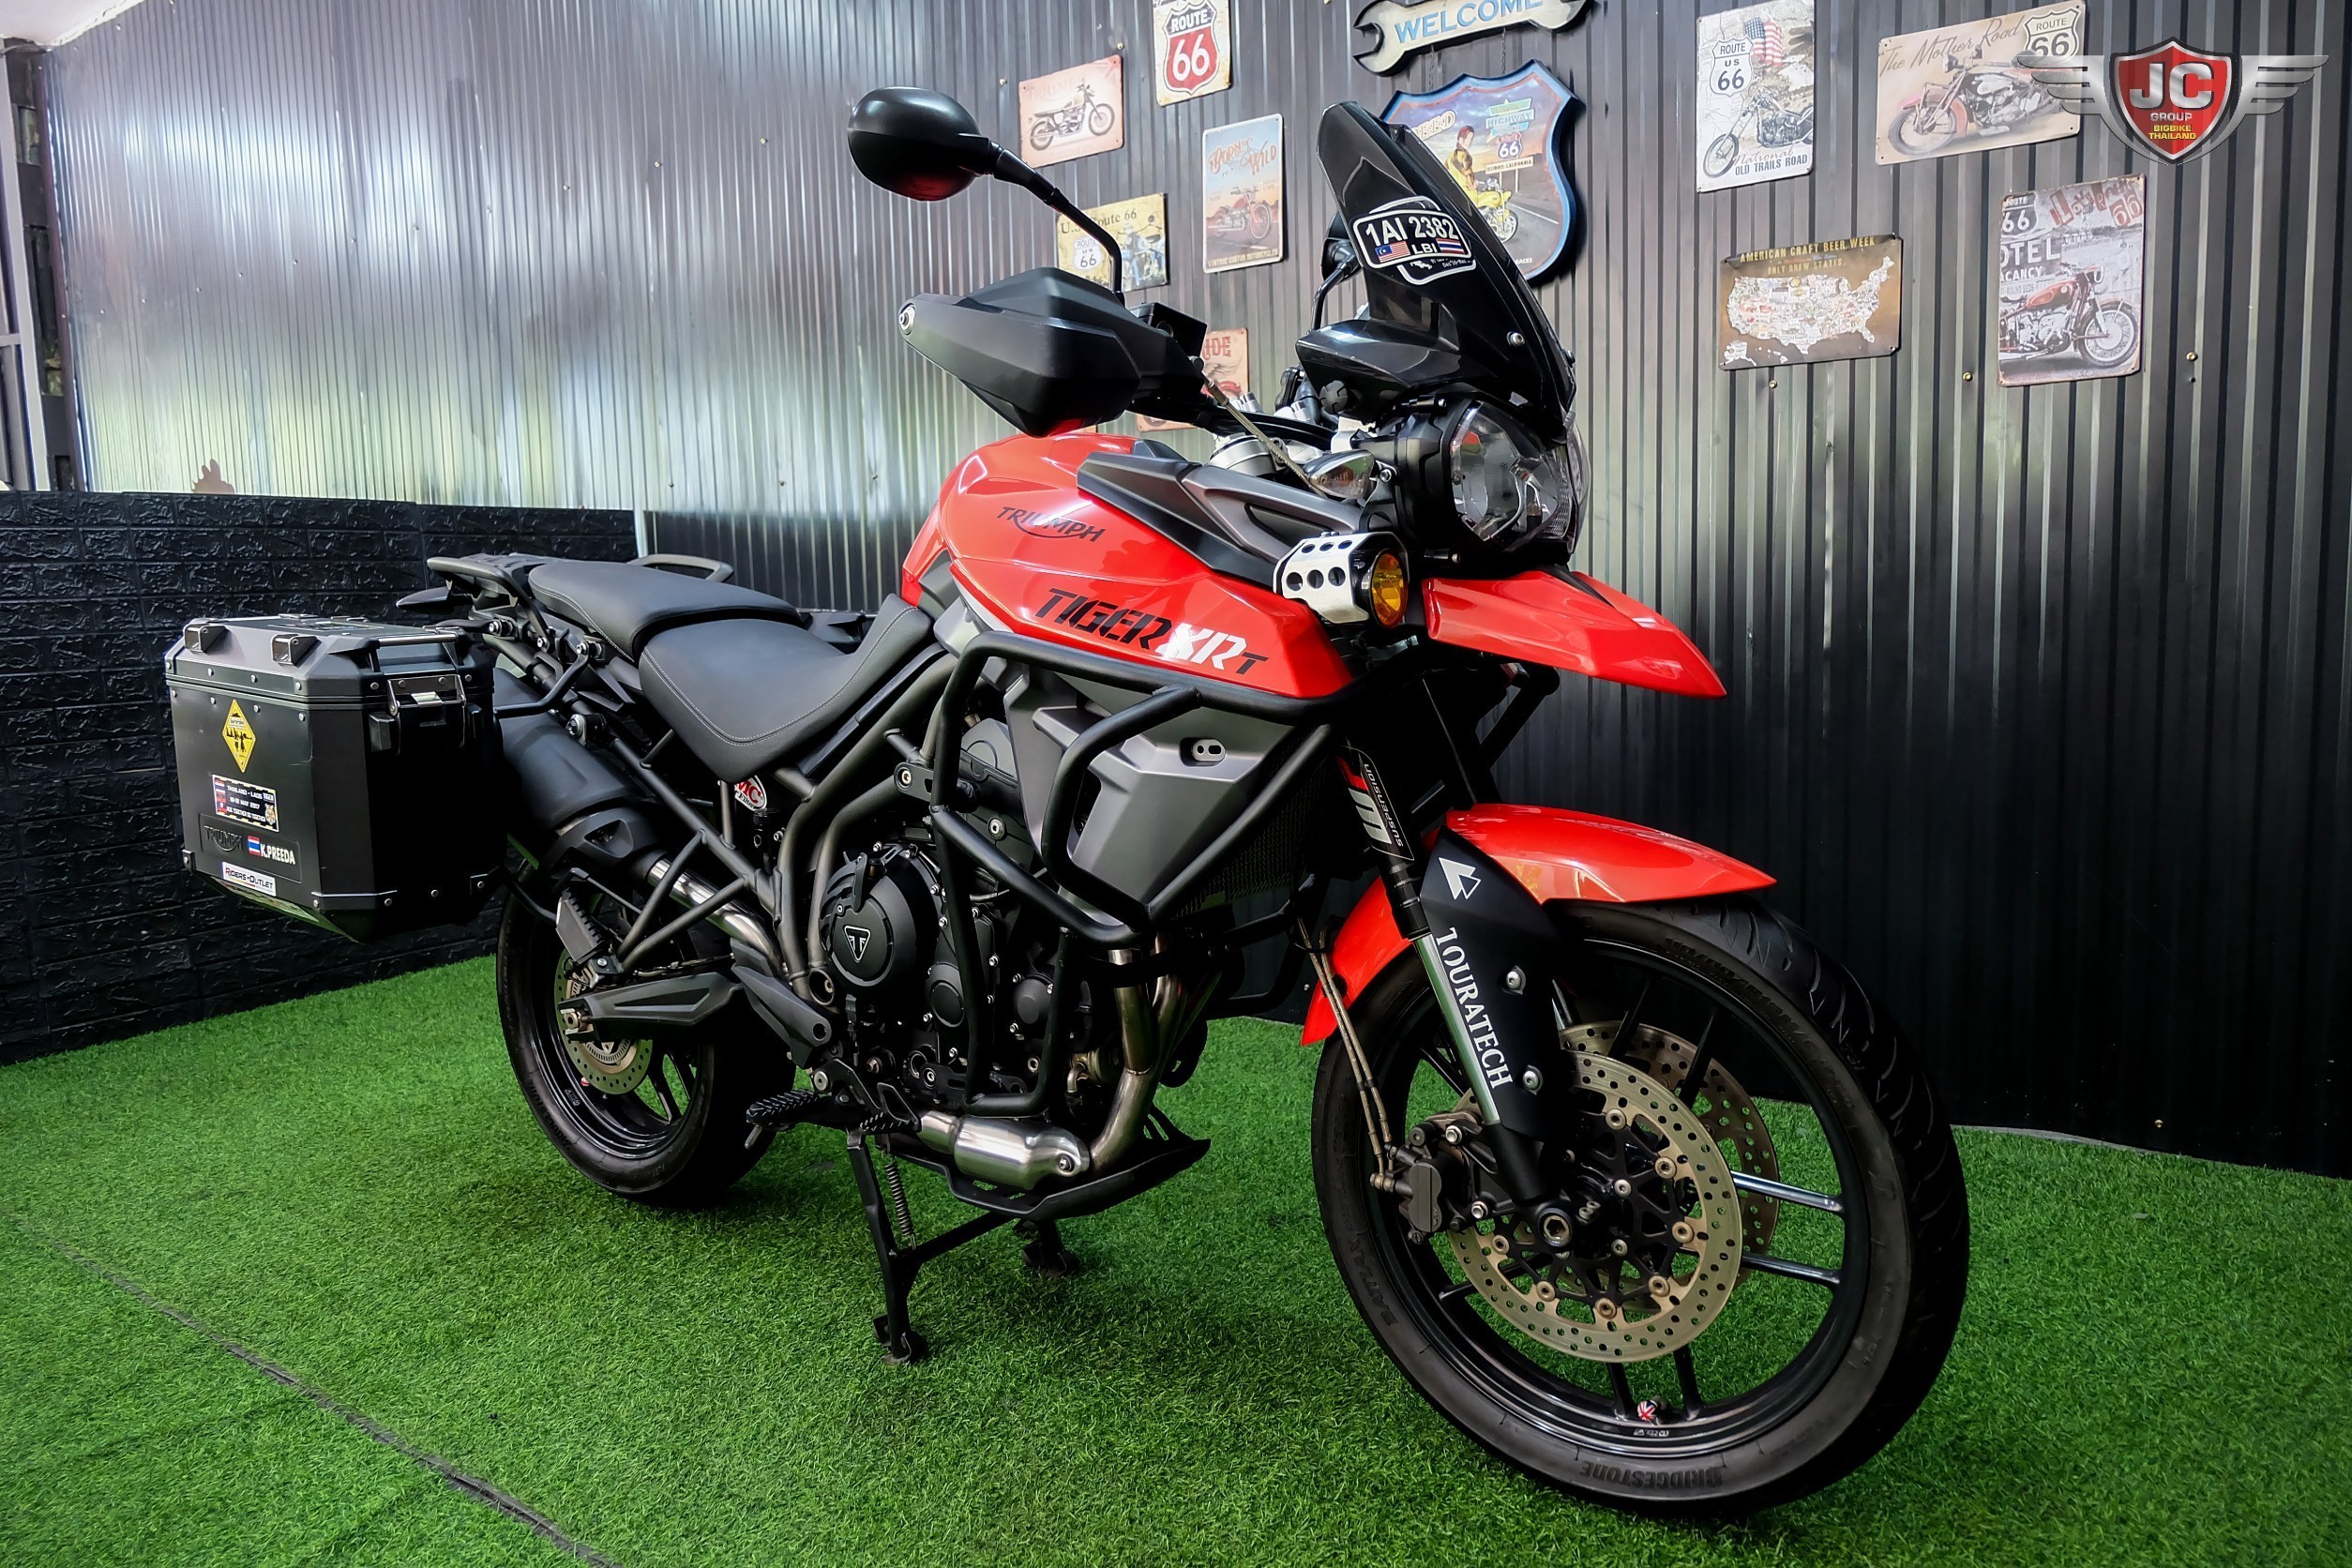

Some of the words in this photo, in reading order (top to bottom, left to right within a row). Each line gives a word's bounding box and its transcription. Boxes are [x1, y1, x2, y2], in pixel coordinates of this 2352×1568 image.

[1171, 8, 1210, 33] ROUTE
[1395, 0, 1543, 43] WELCOME
[2036, 18, 2067, 30] ROUTE
[1172, 34, 1210, 82] 66
[1720, 42, 1746, 55] ROUTE
[1879, 45, 1906, 77] The
[1909, 35, 1973, 69] Mother
[1980, 18, 2025, 47] Road
[2031, 32, 2070, 62] 66
[1717, 68, 1744, 91] 66
[1500, 141, 1519, 158] 66
[1735, 165, 1750, 176] OLD
[1754, 159, 1782, 173] TRAILS
[1785, 154, 1808, 167] ROAD
[1124, 208, 1138, 221] 66
[2002, 210, 2030, 233] 66
[1408, 216, 1459, 239] 2382
[1410, 243, 1438, 255] LBI
[1740, 248, 1787, 264] AMERICAN
[1790, 244, 1818, 257] CRAFT
[1823, 240, 1846, 252] BEER
[1850, 236, 1876, 249] WEEK
[1079, 254, 1097, 268] 66
[1767, 264, 1786, 275] ONLY
[1788, 262, 1810, 273] BREW
[997, 506, 1106, 542] TRIUMPH
[1034, 587, 1172, 650] TIGER
[204, 825, 244, 852] TRIUMPH
[260, 843, 296, 865] K.PREEDA
[1579, 1458, 1724, 1488] BRIDGESTONE
